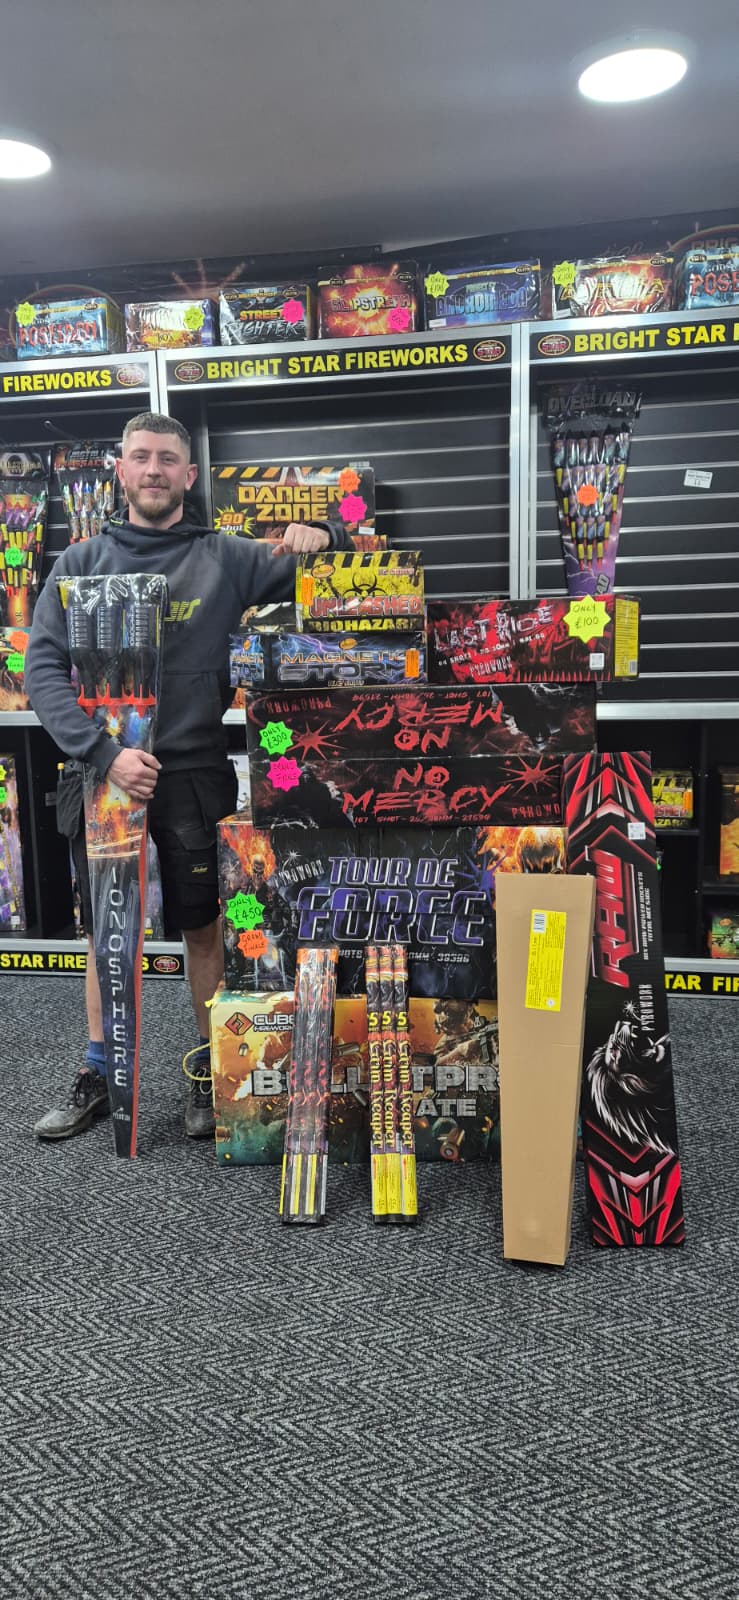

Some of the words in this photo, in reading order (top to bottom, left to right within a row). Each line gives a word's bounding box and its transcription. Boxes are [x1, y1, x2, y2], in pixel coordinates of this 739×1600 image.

[240, 309, 283, 321] STREET
[574, 329, 660, 352] BRIGHT
[666, 324, 726, 347] STAR
[206, 358, 282, 379] BRIGHT
[288, 354, 341, 375] STAR
[345, 344, 468, 370] FIREWORKS
[3, 369, 112, 393] FIREWORKS
[237, 485, 345, 503] DANGER
[221, 512, 244, 525] 90
[255, 503, 329, 522] ZONE
[310, 594, 422, 618] UNLEASHED
[572, 604, 597, 613] ONLY
[434, 618, 490, 650] LAST
[495, 604, 553, 642] RIDE
[575, 617, 599, 630] £100
[280, 650, 406, 664] MAGNETIC
[332, 700, 503, 731] MERCY
[262, 727, 281, 738] ONLY
[266, 732, 288, 748] £300
[393, 726, 451, 753] NO
[393, 762, 450, 791] NO
[342, 784, 512, 815] MERCY
[328, 856, 412, 886] TOUR
[415, 858, 458, 887] DE
[229, 897, 251, 908] ONLY
[234, 906, 262, 923] £450
[296, 887, 487, 946] FORCE
[590, 848, 634, 988] RAW
[0, 953, 44, 969] STAR
[108, 866, 127, 1088] IONOSPHERE
[664, 974, 701, 991] TAR
[369, 1011, 378, 1026] 5
[382, 1010, 391, 1025] 5
[398, 1011, 407, 1026] 5
[415, 1098, 477, 1117] ATE
[370, 1089, 383, 1148] Reaper
[384, 1089, 397, 1147] Reaper
[400, 1089, 413, 1148] Reaper
